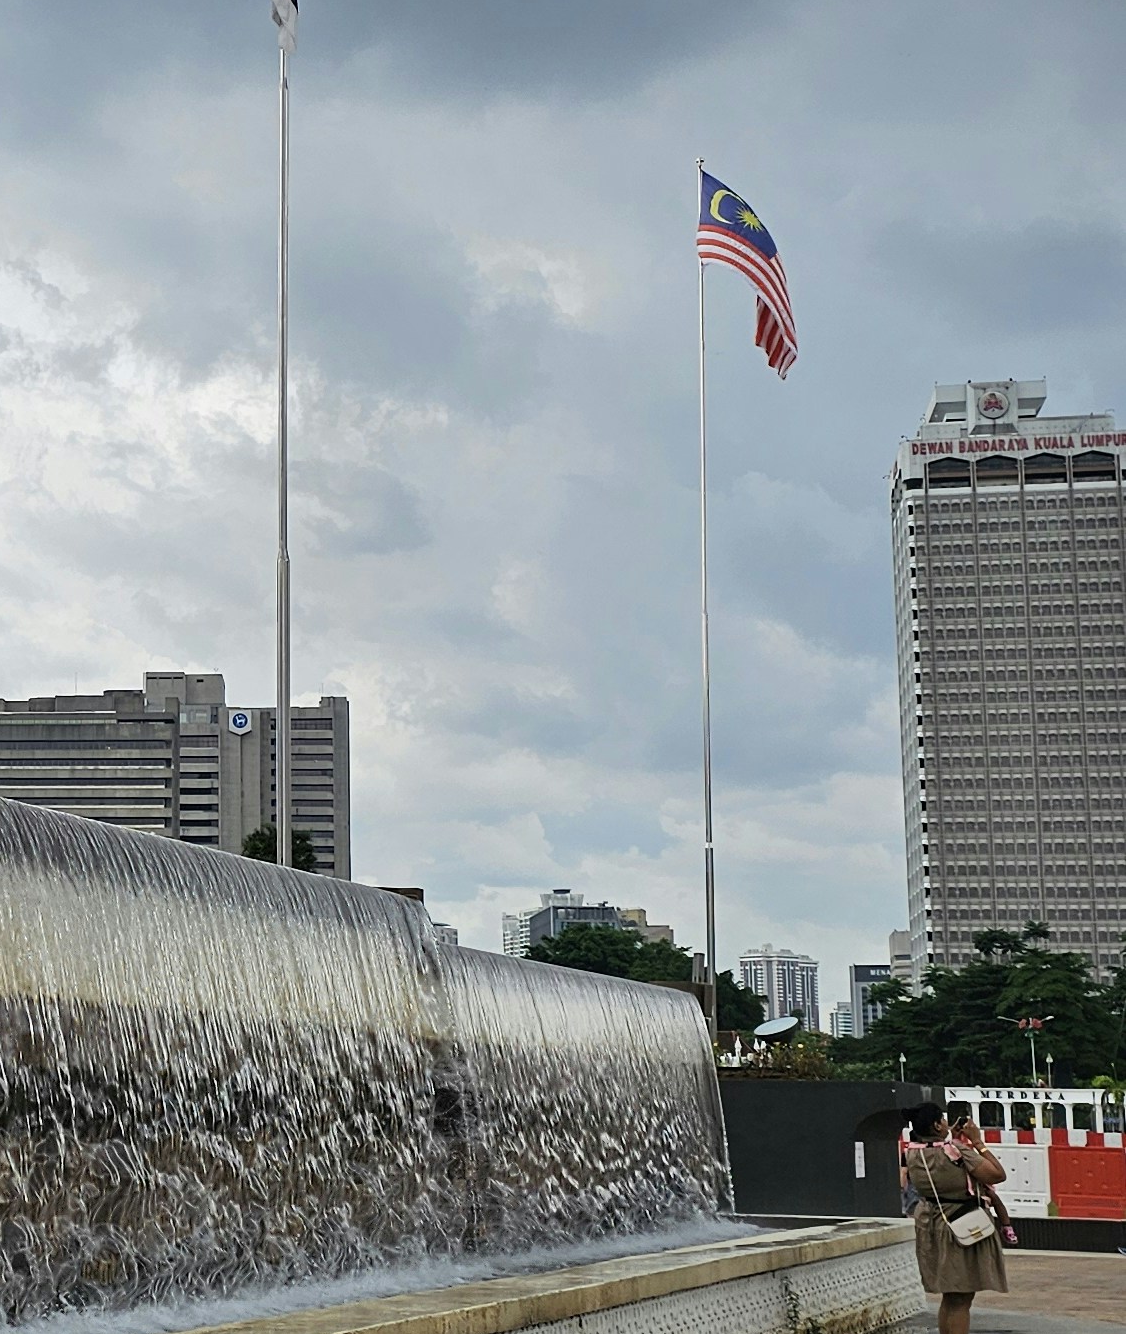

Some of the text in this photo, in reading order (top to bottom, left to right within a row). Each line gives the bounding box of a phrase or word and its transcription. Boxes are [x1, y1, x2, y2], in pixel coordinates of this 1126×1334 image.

[912, 442, 953, 455] DEWAN
[959, 438, 1029, 453] BANDARAYA
[1034, 435, 1075, 450] KUALA
[980, 1090, 1066, 1101] MERDEKA
